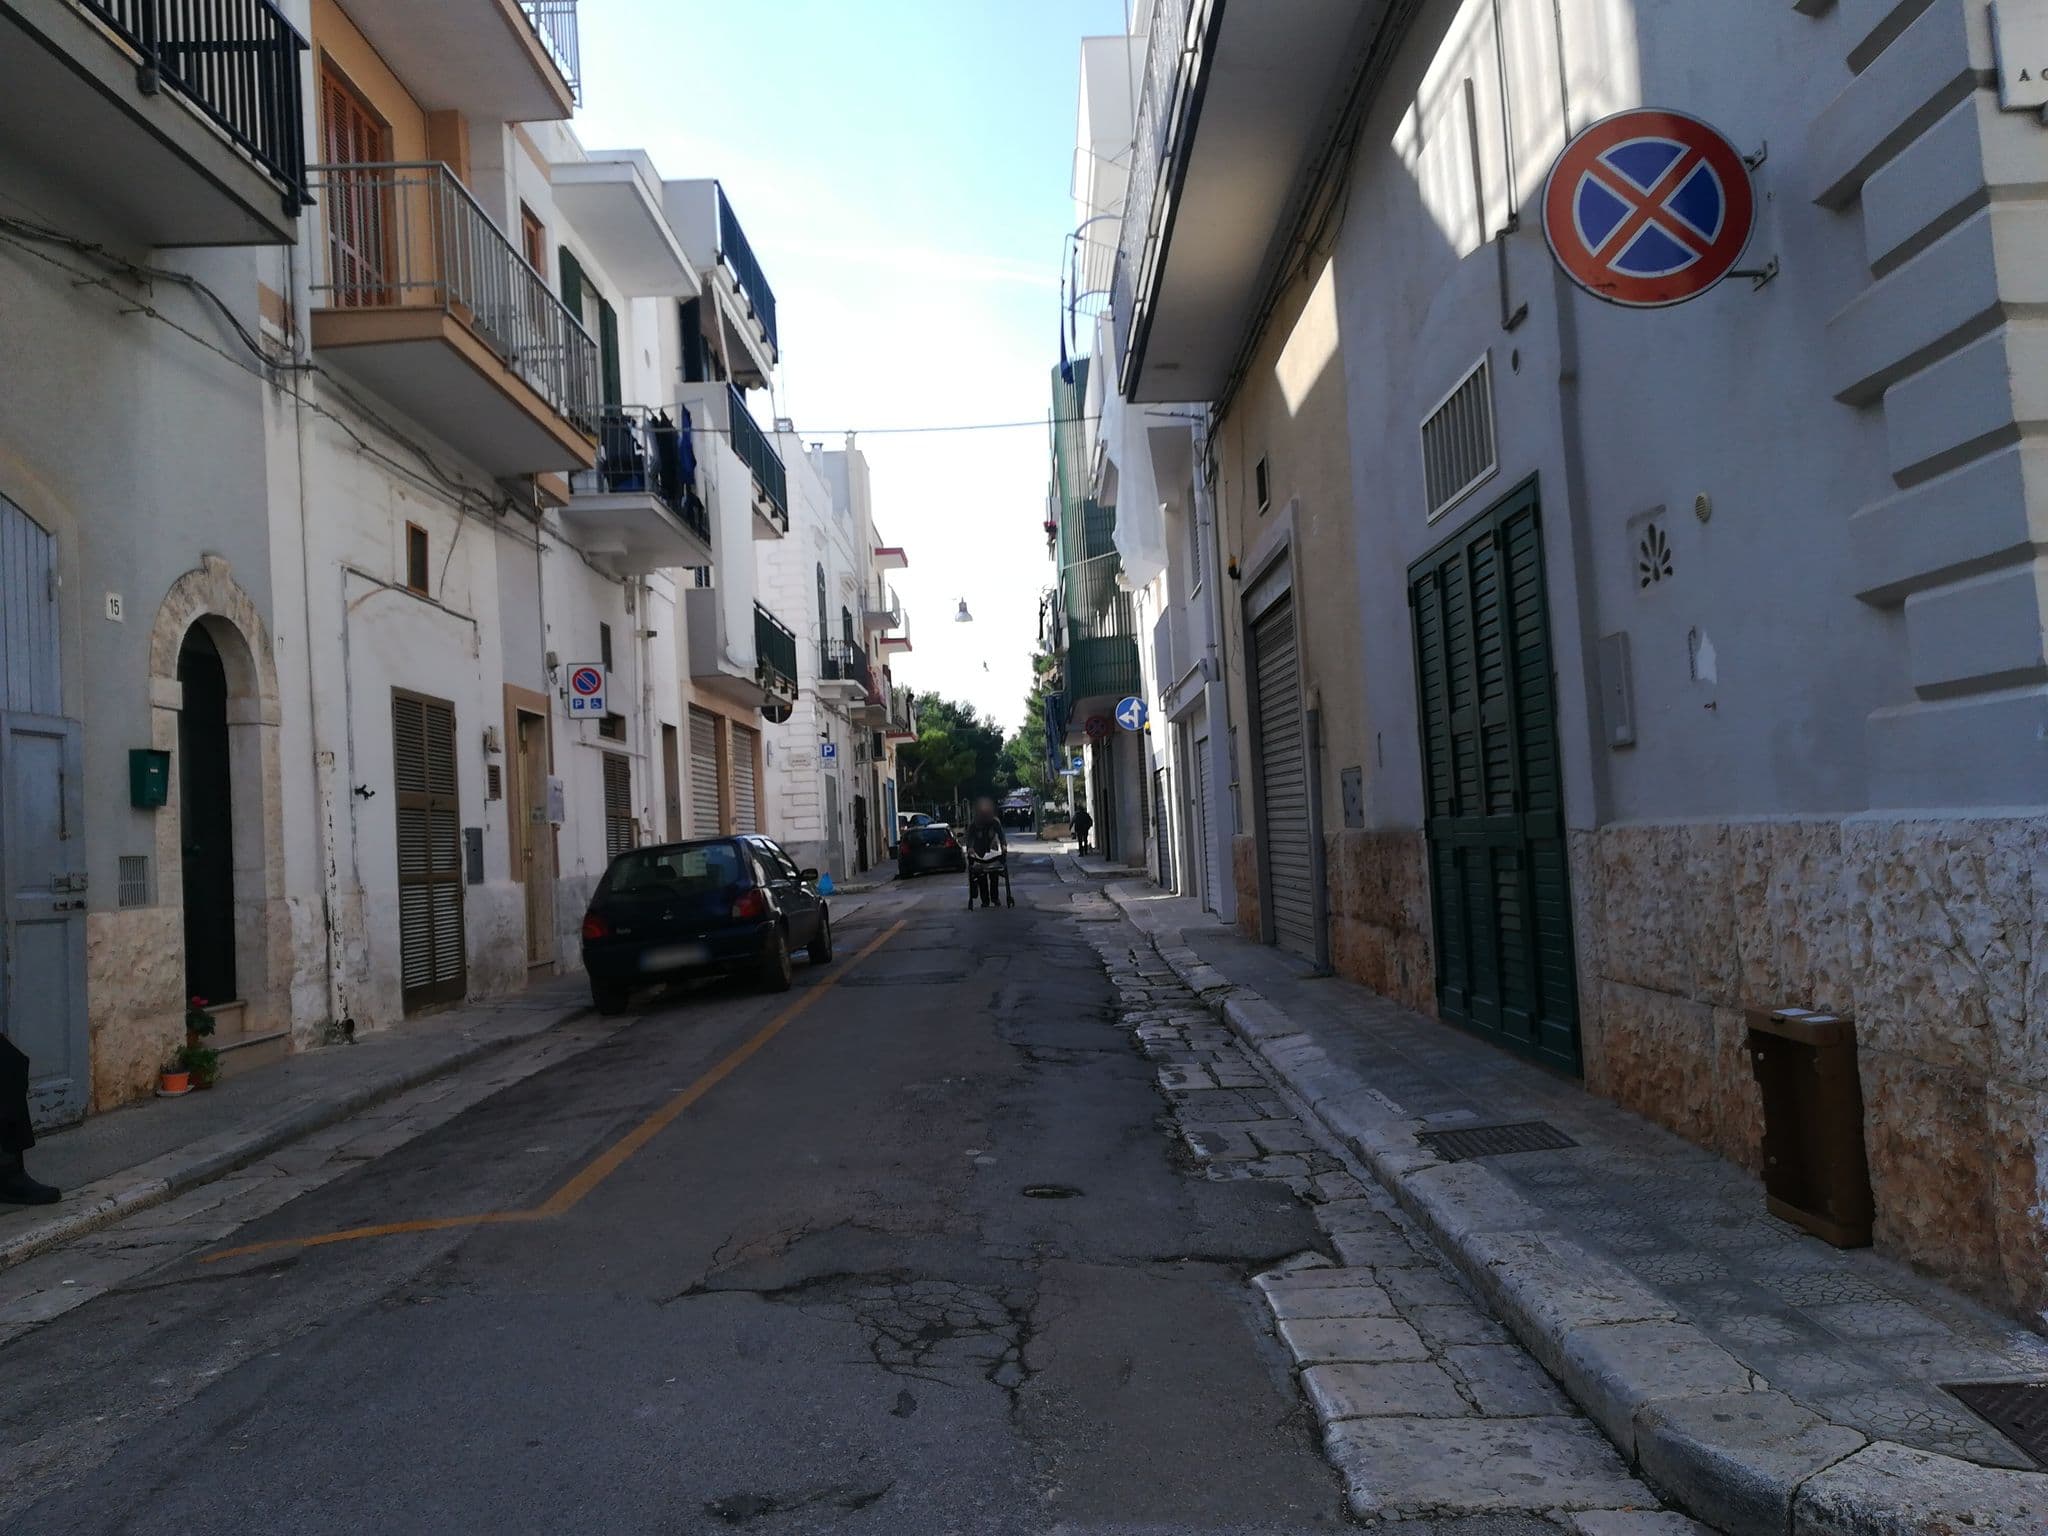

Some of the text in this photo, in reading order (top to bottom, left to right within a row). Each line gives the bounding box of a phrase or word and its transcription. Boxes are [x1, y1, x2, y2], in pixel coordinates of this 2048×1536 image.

[110, 597, 120, 616] 15
[575, 699, 583, 708] P
[823, 745, 833, 756] P
